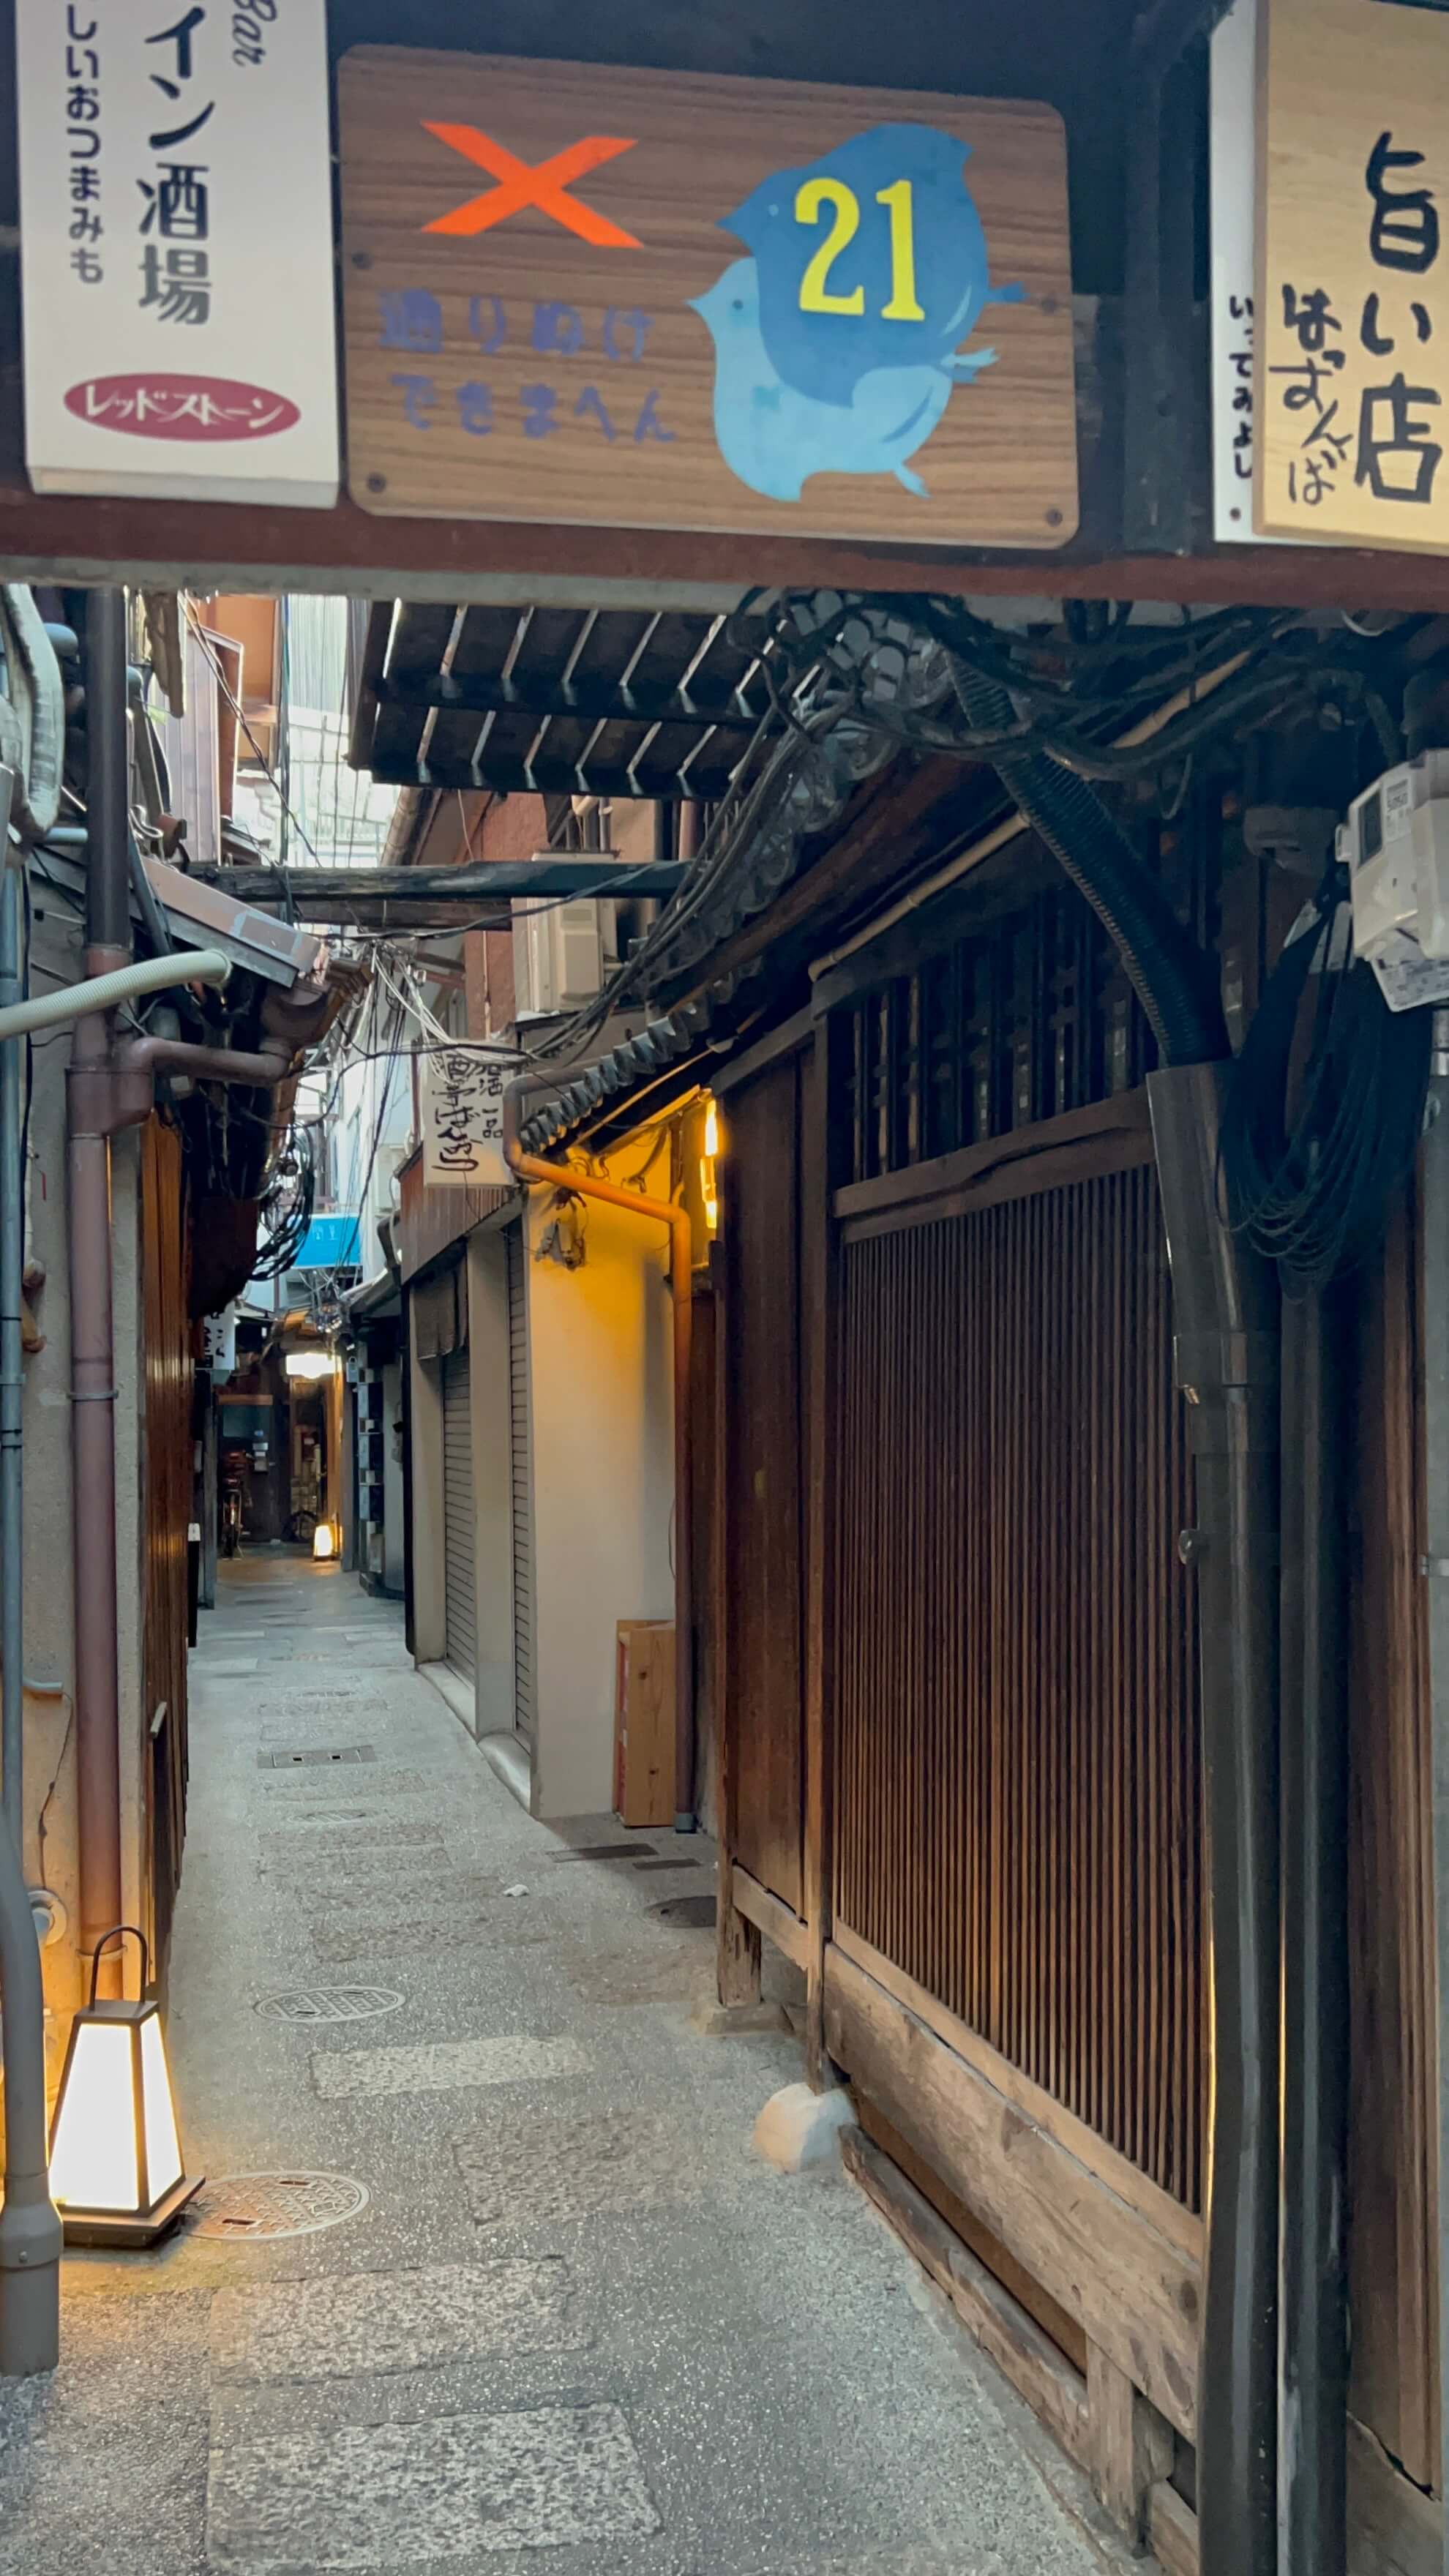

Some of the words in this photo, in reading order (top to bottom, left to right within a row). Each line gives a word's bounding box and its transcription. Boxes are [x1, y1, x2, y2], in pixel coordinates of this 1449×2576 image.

[67, 4, 103, 285] しいおつまみも
[137, 7, 215, 325] イン酒場
[795, 177, 925, 321] 21
[1354, 131, 1442, 503] 旨い店
[378, 287, 656, 363] 通りぬけ
[86, 384, 285, 429] レッドストーン
[388, 374, 678, 444] できまへん
